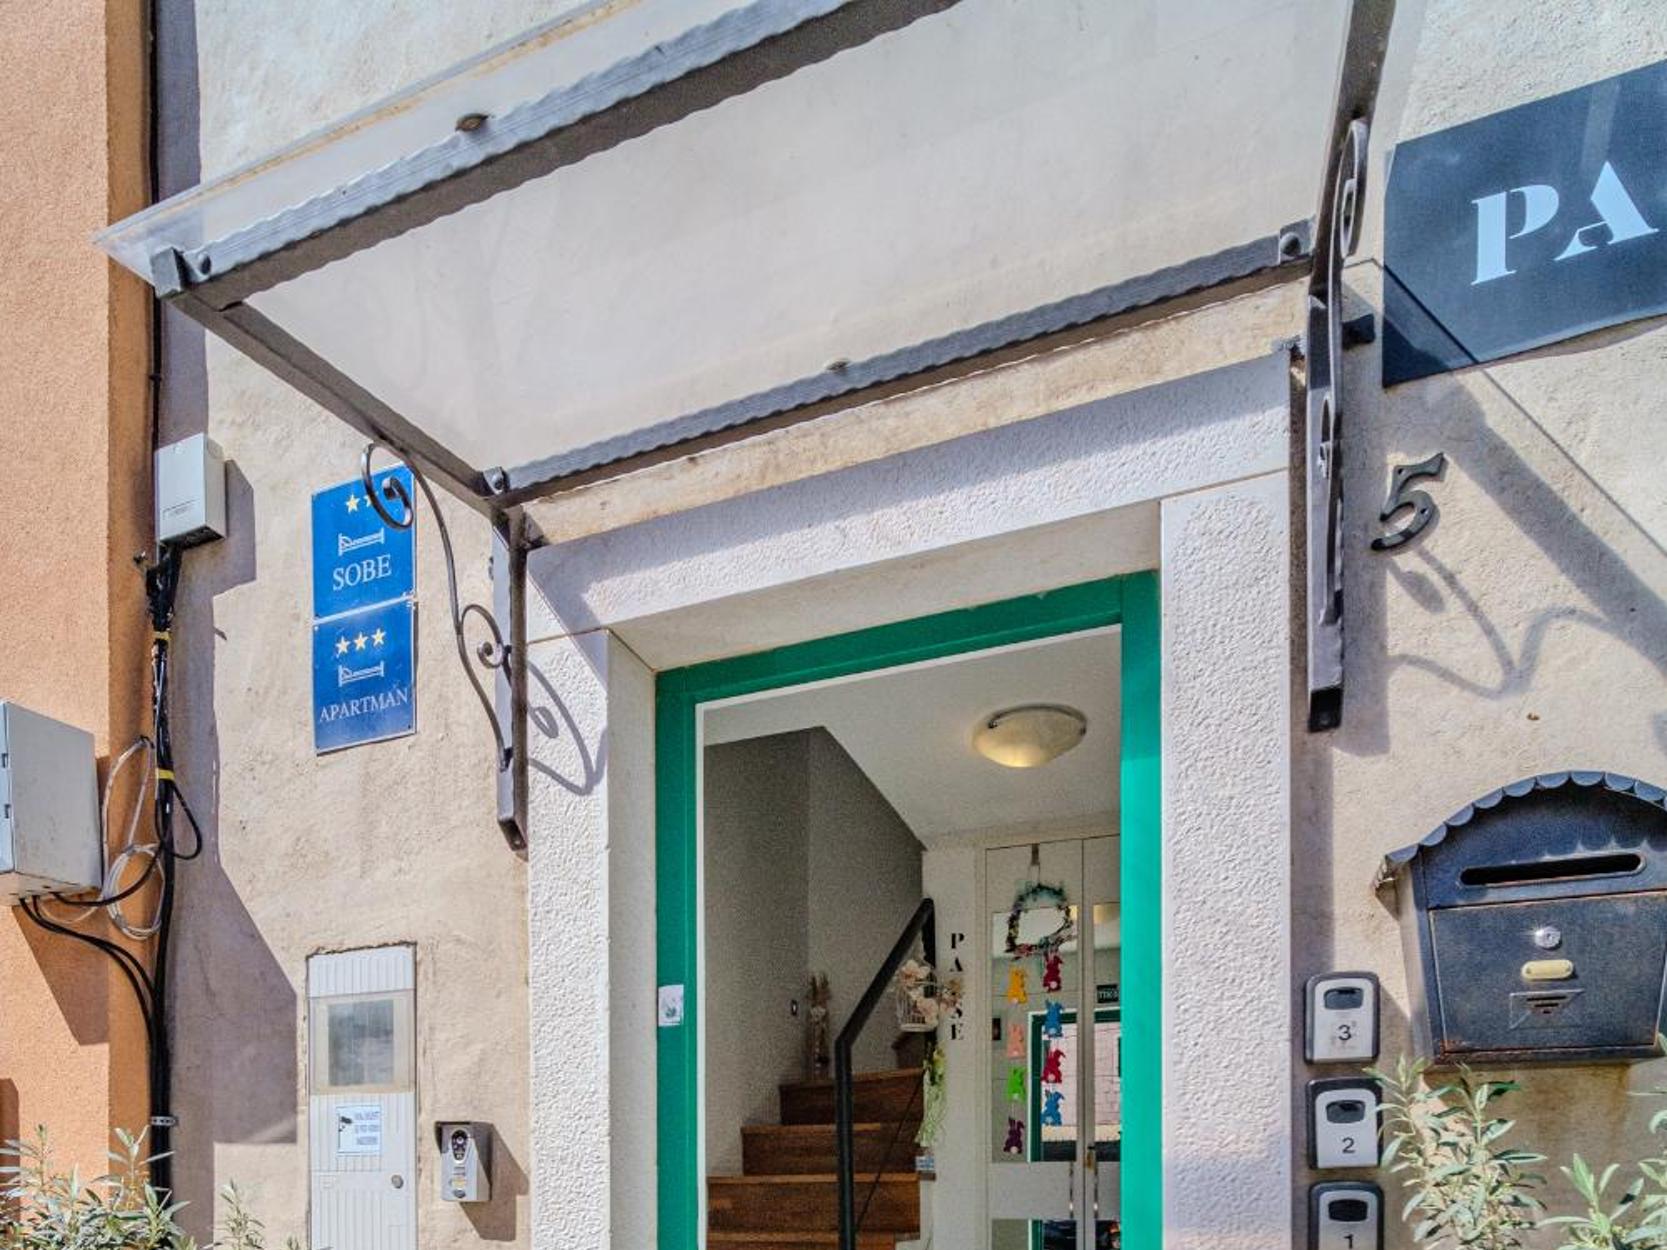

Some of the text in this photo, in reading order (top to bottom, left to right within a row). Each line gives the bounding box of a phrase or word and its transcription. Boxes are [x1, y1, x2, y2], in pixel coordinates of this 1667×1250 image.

[1370, 451, 1446, 552] 5
[332, 553, 393, 592] SOBE
[319, 687, 409, 724] APARTMAN
[1337, 1023, 1352, 1042] 3
[1341, 1136, 1355, 1155] 2
[1344, 1233, 1354, 1250] 1
